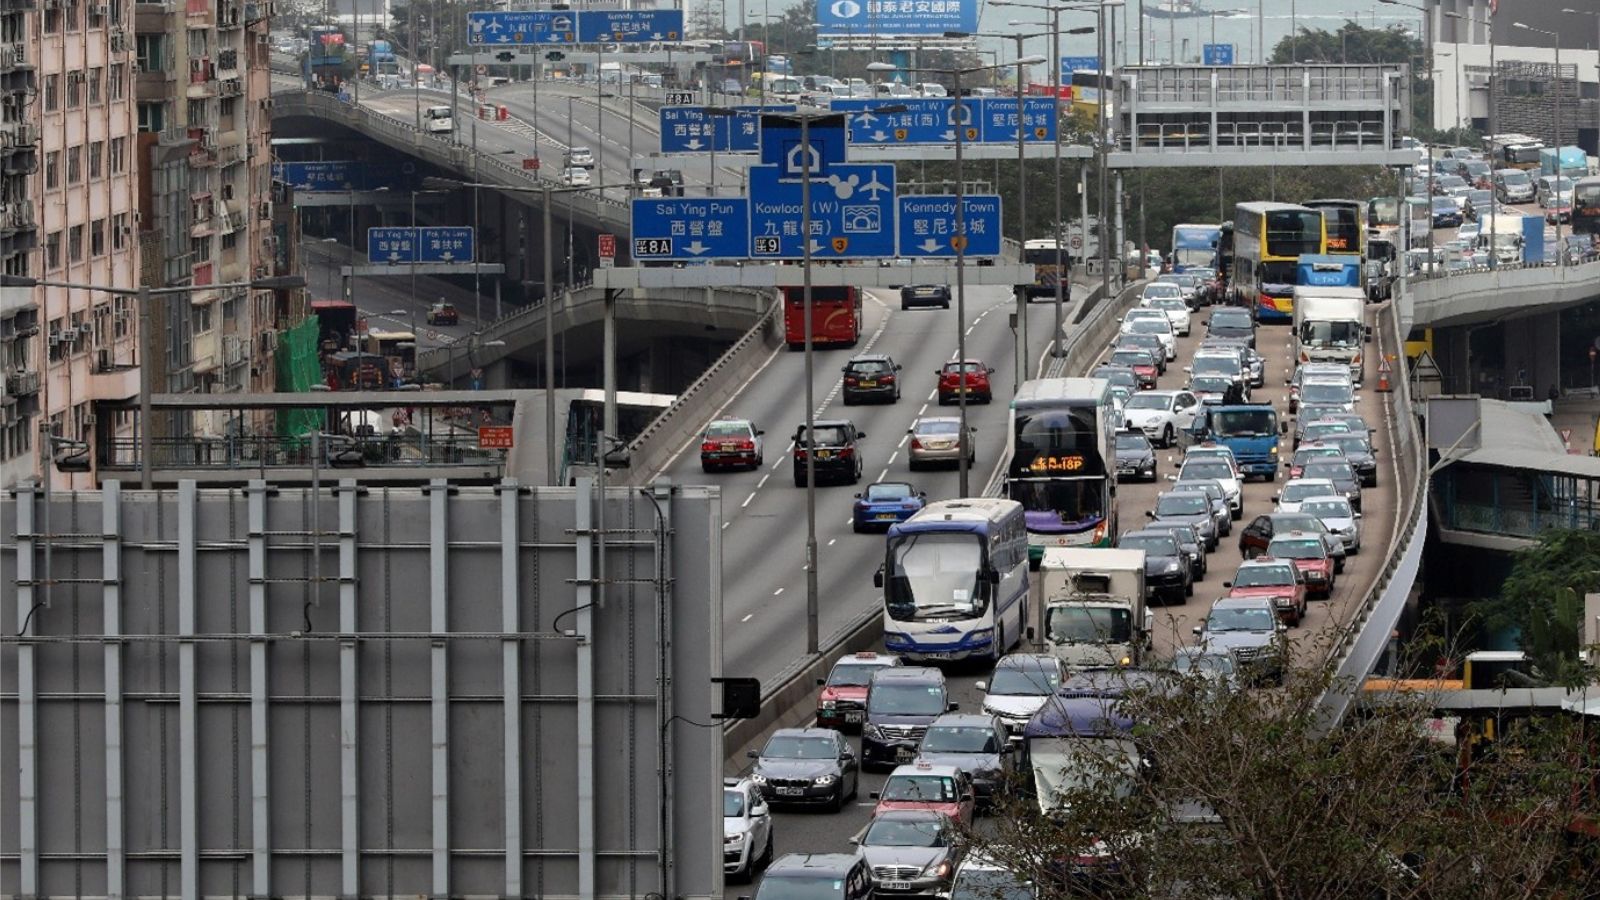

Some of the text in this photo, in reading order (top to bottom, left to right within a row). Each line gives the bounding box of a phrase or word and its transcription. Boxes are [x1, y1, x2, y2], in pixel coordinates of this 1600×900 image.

[1030, 101, 1054, 110] Town
[665, 111, 679, 119] Sai
[684, 111, 703, 121] Ying
[656, 203, 733, 217] Sai Ying Pun
[812, 201, 839, 213] (W)
[904, 201, 995, 215] Kennedy Town
[671, 220, 723, 236] 西營盤
[764, 219, 831, 236] 九龍(西)
[1062, 459, 1082, 470] 18P
